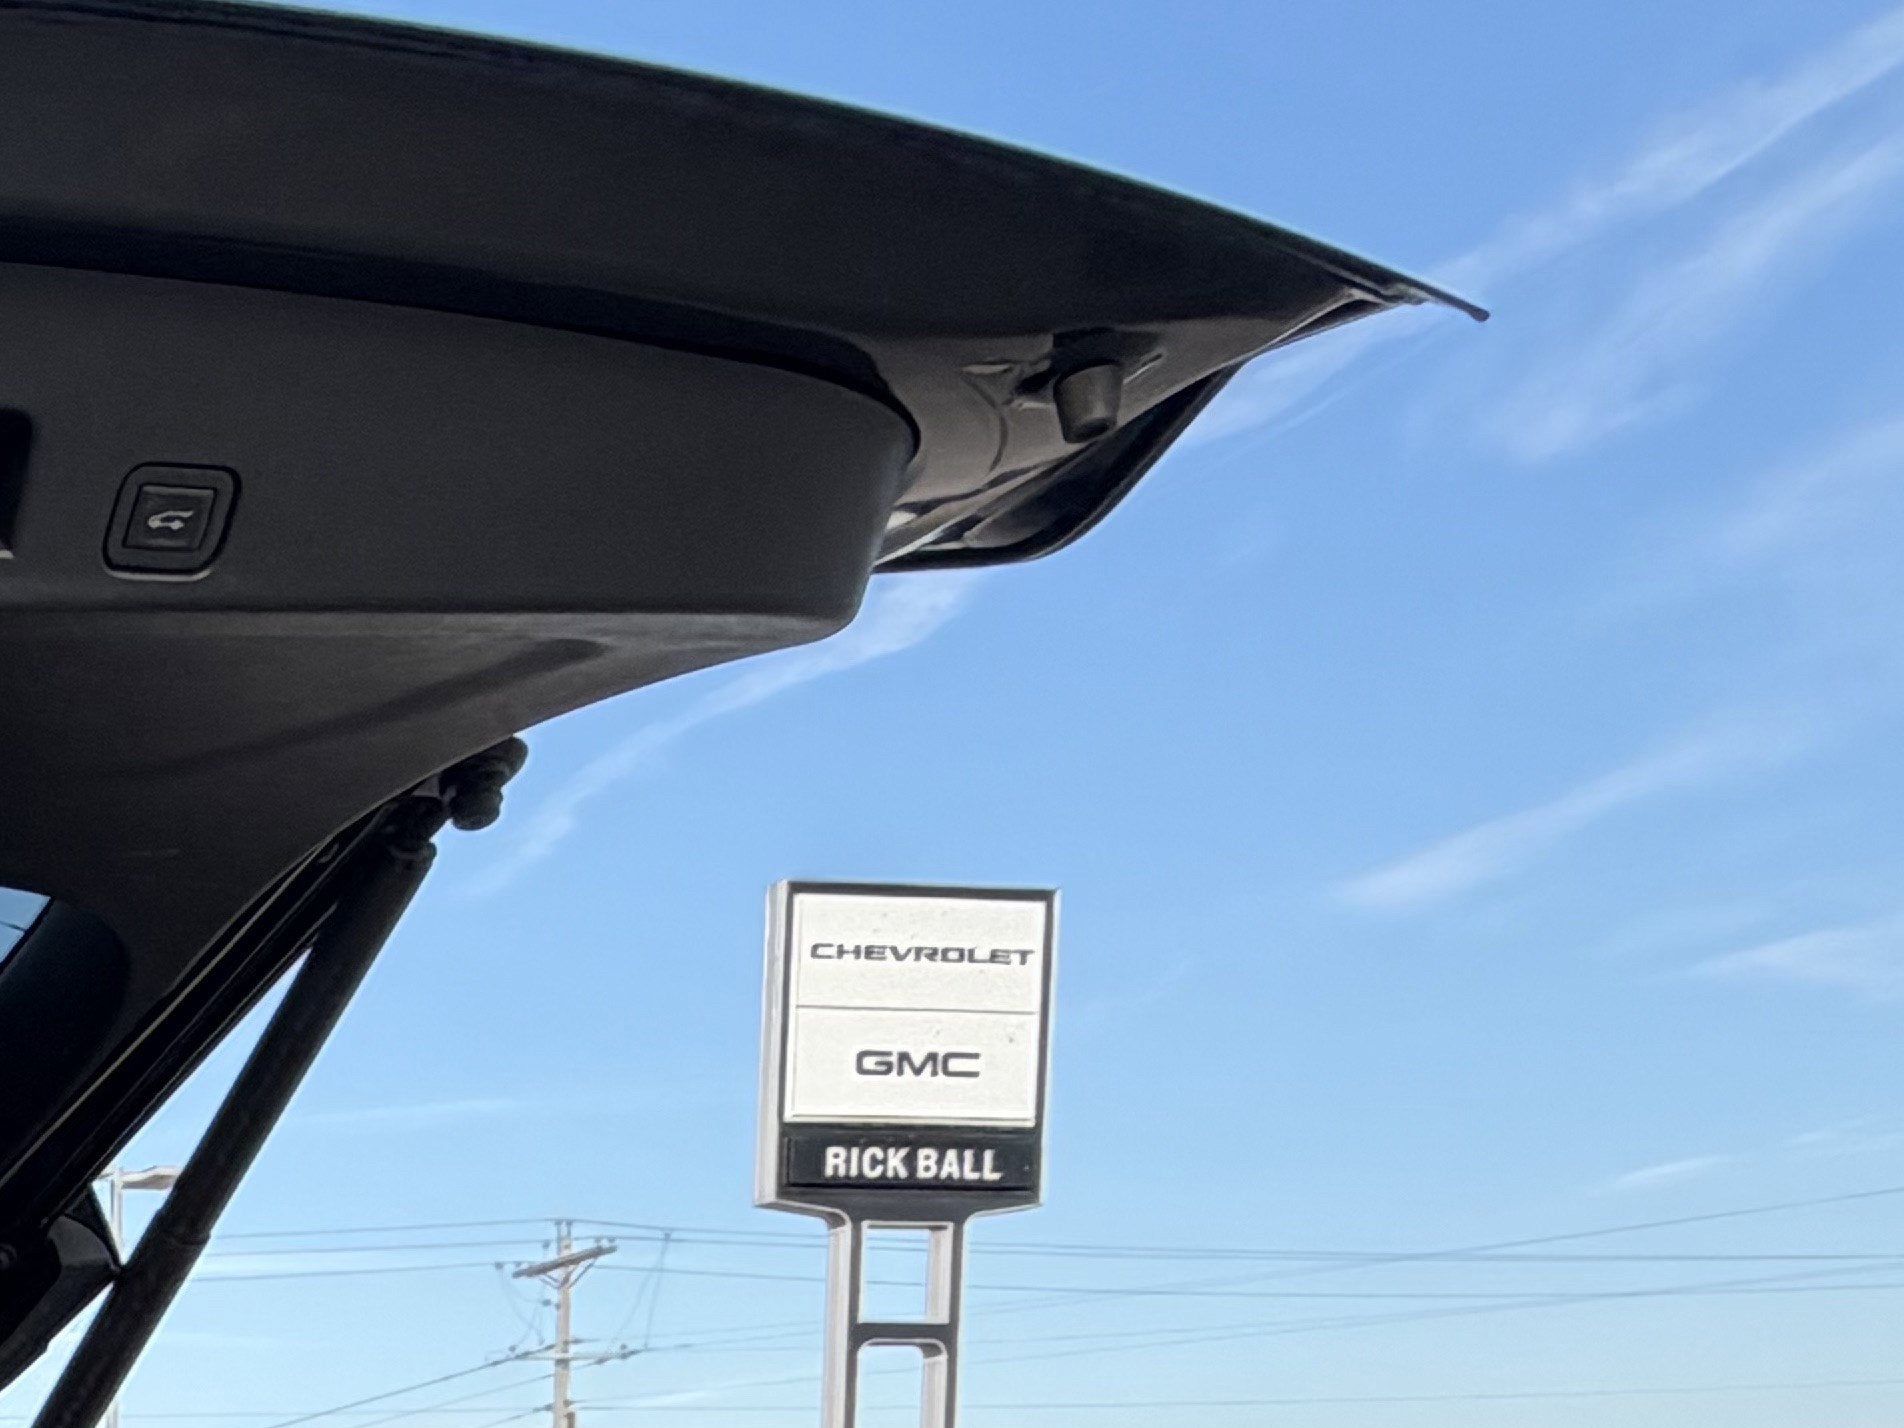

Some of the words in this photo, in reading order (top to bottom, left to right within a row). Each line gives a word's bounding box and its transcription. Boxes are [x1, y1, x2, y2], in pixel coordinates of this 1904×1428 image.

[809, 942, 1035, 966] CHEVROLET
[855, 1049, 981, 1078] GMC
[824, 1145, 910, 1179] RICK
[915, 1147, 1003, 1181] BALL
